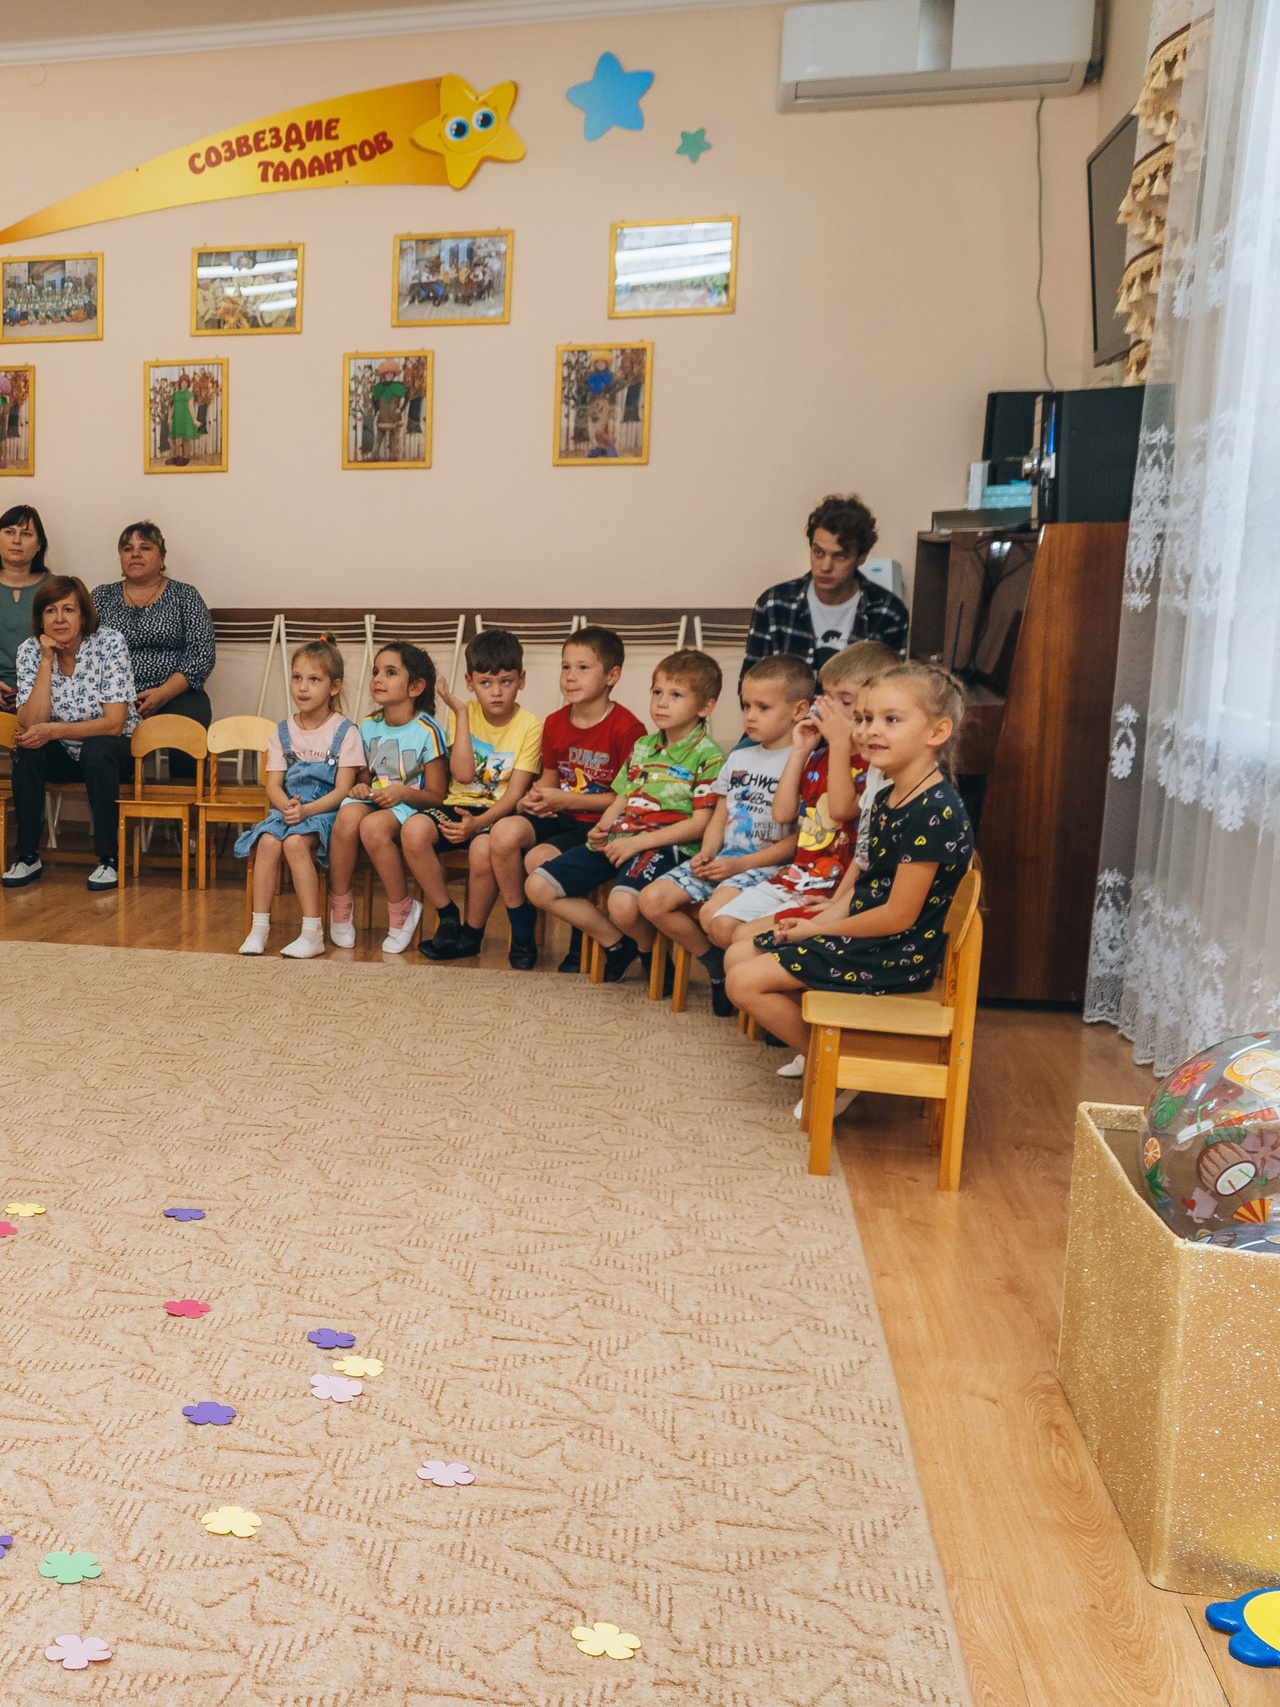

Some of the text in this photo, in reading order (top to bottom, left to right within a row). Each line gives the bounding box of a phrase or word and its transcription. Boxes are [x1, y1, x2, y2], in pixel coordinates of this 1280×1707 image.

[188, 118, 341, 175] СОЗВЕЗДИЕ
[258, 130, 394, 183] ТАЛАНТОВ
[569, 746, 610, 768] DUMP
